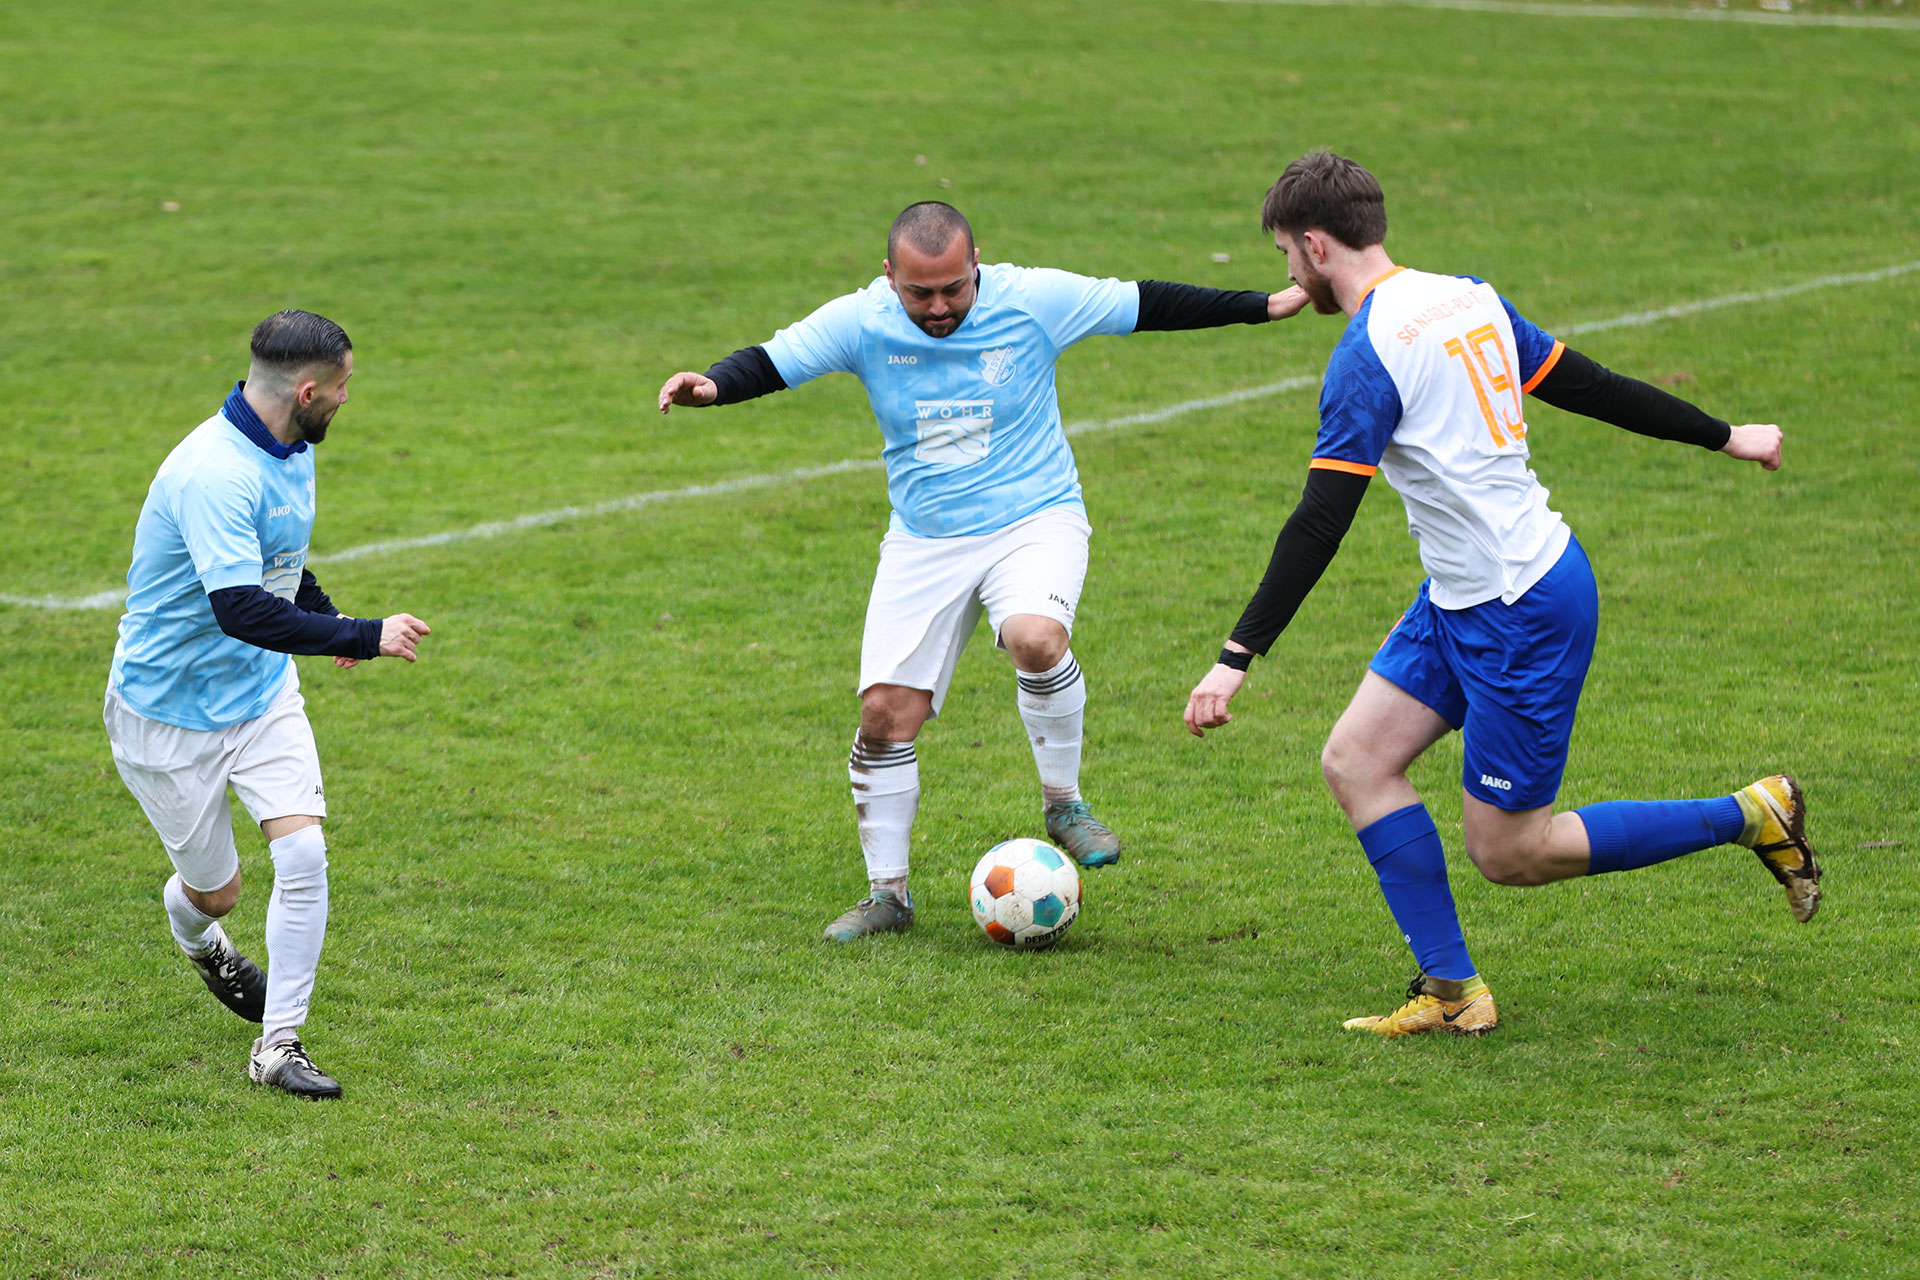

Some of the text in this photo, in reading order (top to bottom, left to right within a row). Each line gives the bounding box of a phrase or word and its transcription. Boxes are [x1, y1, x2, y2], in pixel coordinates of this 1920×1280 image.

[1397, 324, 1419, 345] SG
[887, 355, 918, 365] JAKO
[1443, 322, 1526, 448] 19
[268, 504, 291, 519] JAKO
[1048, 593, 1070, 611] JAKO
[314, 784, 323, 796] JA
[1480, 774, 1512, 791] JAKO
[292, 998, 308, 1008] JA
